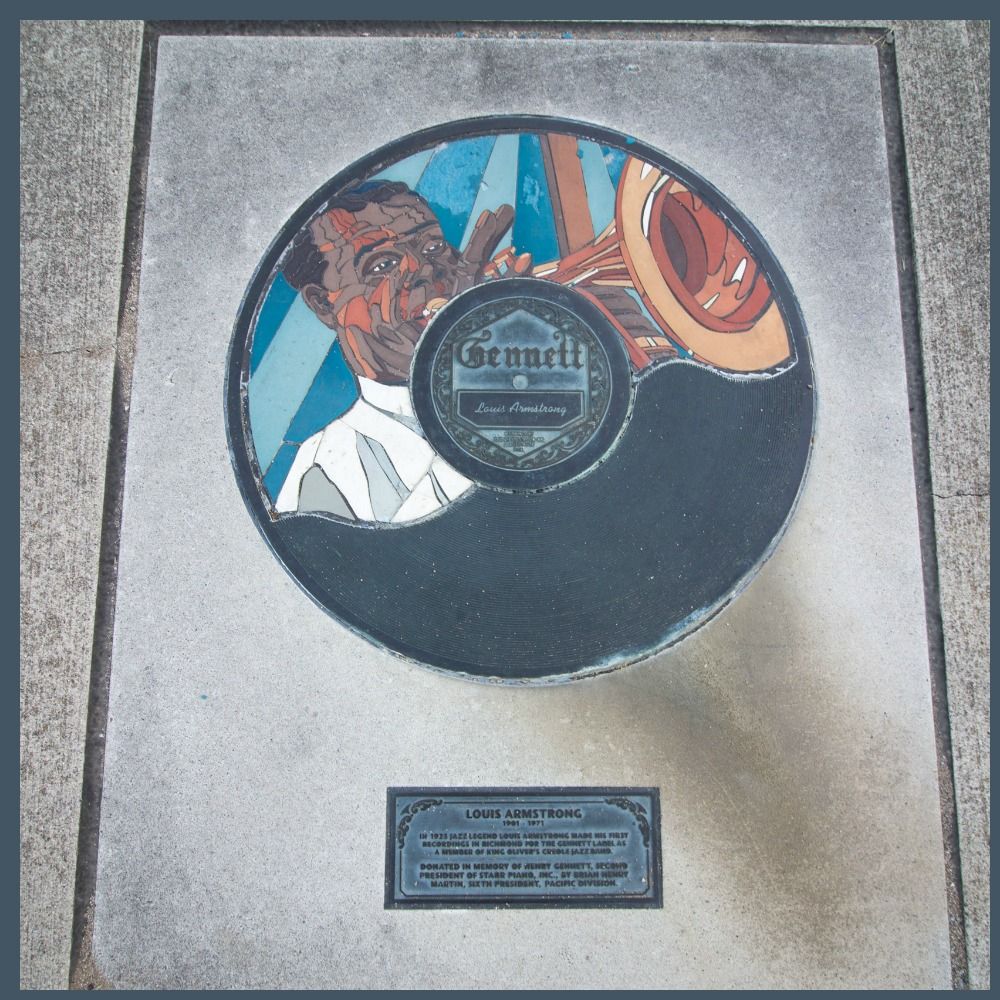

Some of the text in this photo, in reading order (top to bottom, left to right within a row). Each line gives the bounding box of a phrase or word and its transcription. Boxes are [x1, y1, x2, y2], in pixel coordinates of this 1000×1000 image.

[454, 330, 584, 370] Gennett
[474, 401, 567, 416] Louis Armstrong
[466, 808, 582, 819] LOUIS ARMSTRONG
[450, 832, 468, 840] JAZZ
[508, 872, 536, 880] PIANO,
[430, 880, 466, 889] MARTIN,
